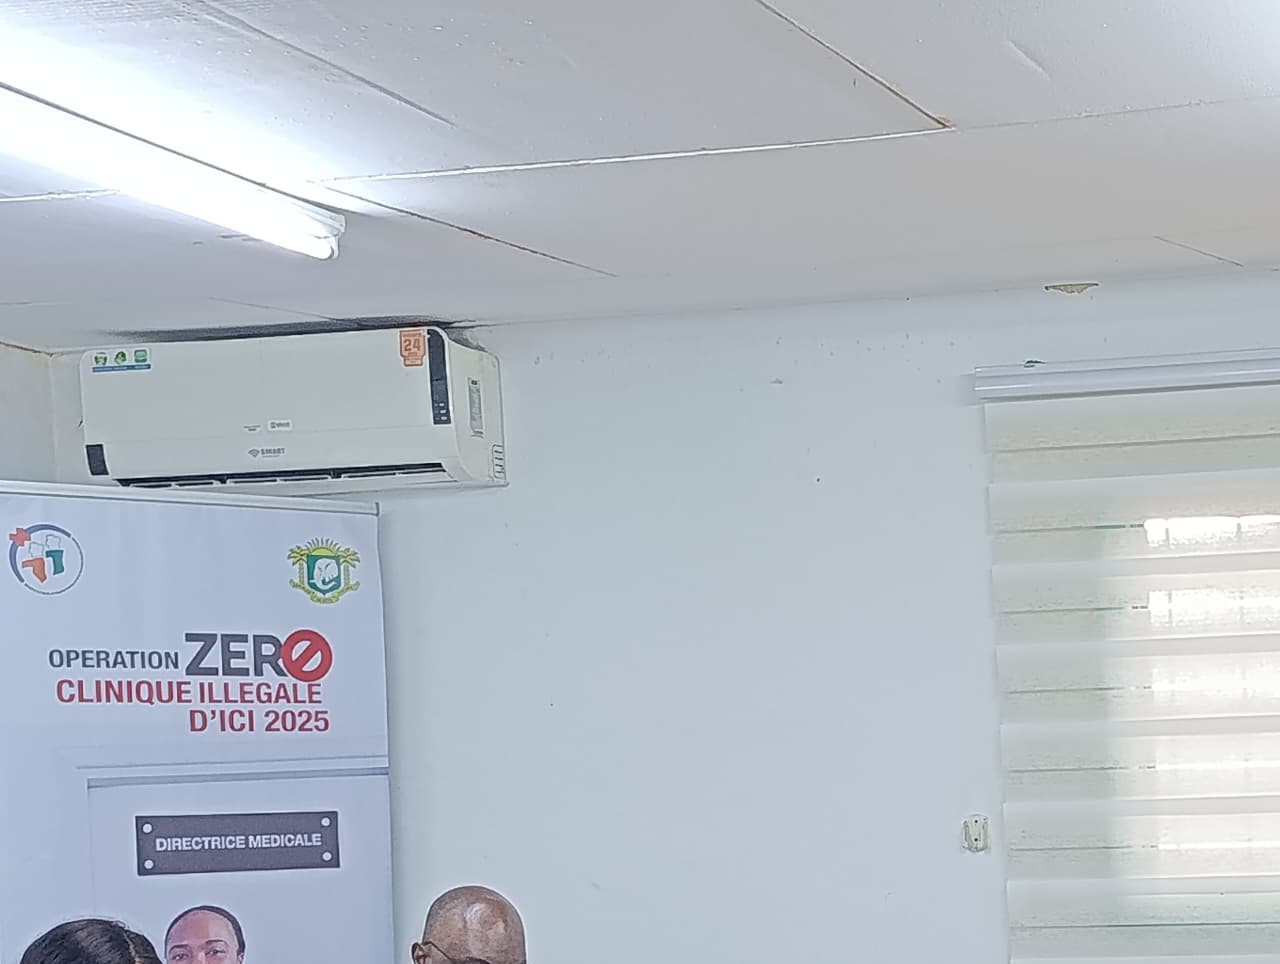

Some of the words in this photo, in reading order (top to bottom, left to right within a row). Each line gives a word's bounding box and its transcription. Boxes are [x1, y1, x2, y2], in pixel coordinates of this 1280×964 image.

[404, 338, 420, 351] 24
[48, 648, 179, 669] OPERATION
[56, 679, 193, 705] CLINIQUE
[199, 681, 322, 704] ILLEGALE
[264, 709, 330, 732] 2025
[155, 836, 246, 851] DIRECTRICE
[248, 833, 322, 848] MEDICALE
